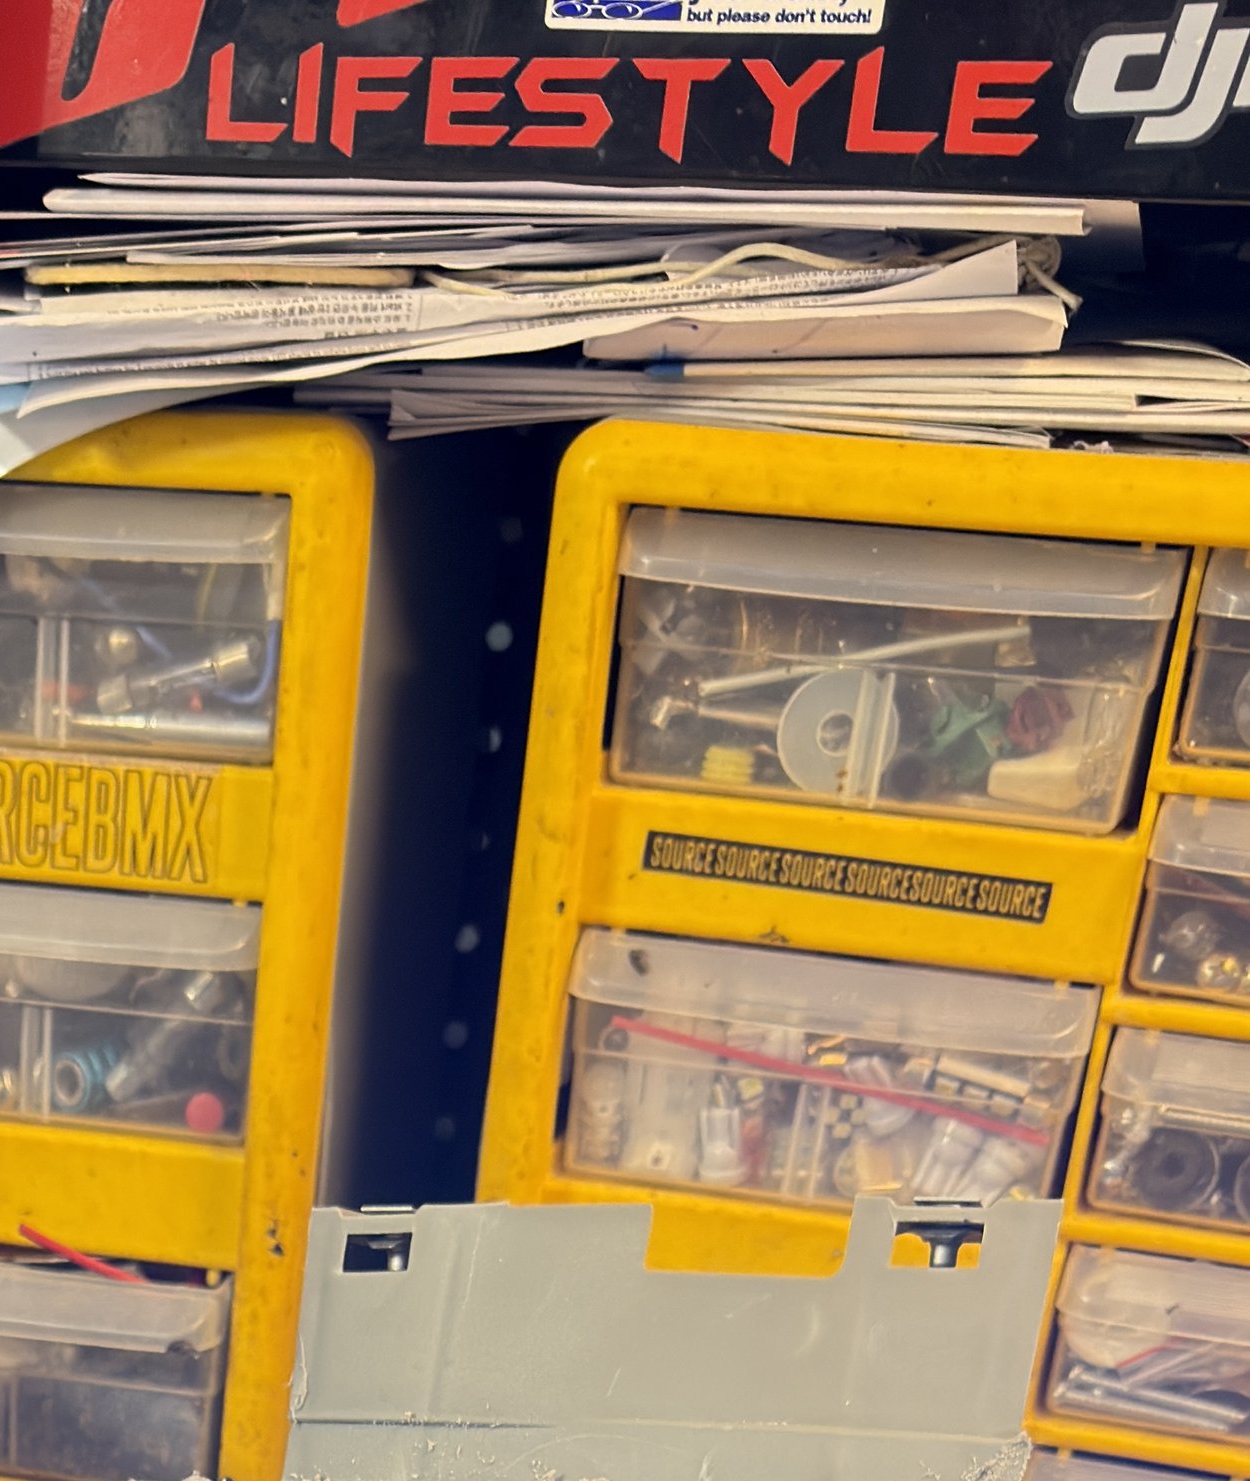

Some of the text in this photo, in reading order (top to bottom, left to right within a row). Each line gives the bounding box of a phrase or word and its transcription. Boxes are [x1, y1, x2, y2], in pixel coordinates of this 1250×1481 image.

[686, 8, 872, 25] but please don't touch!
[206, 42, 1053, 166] LIFESTYLE
